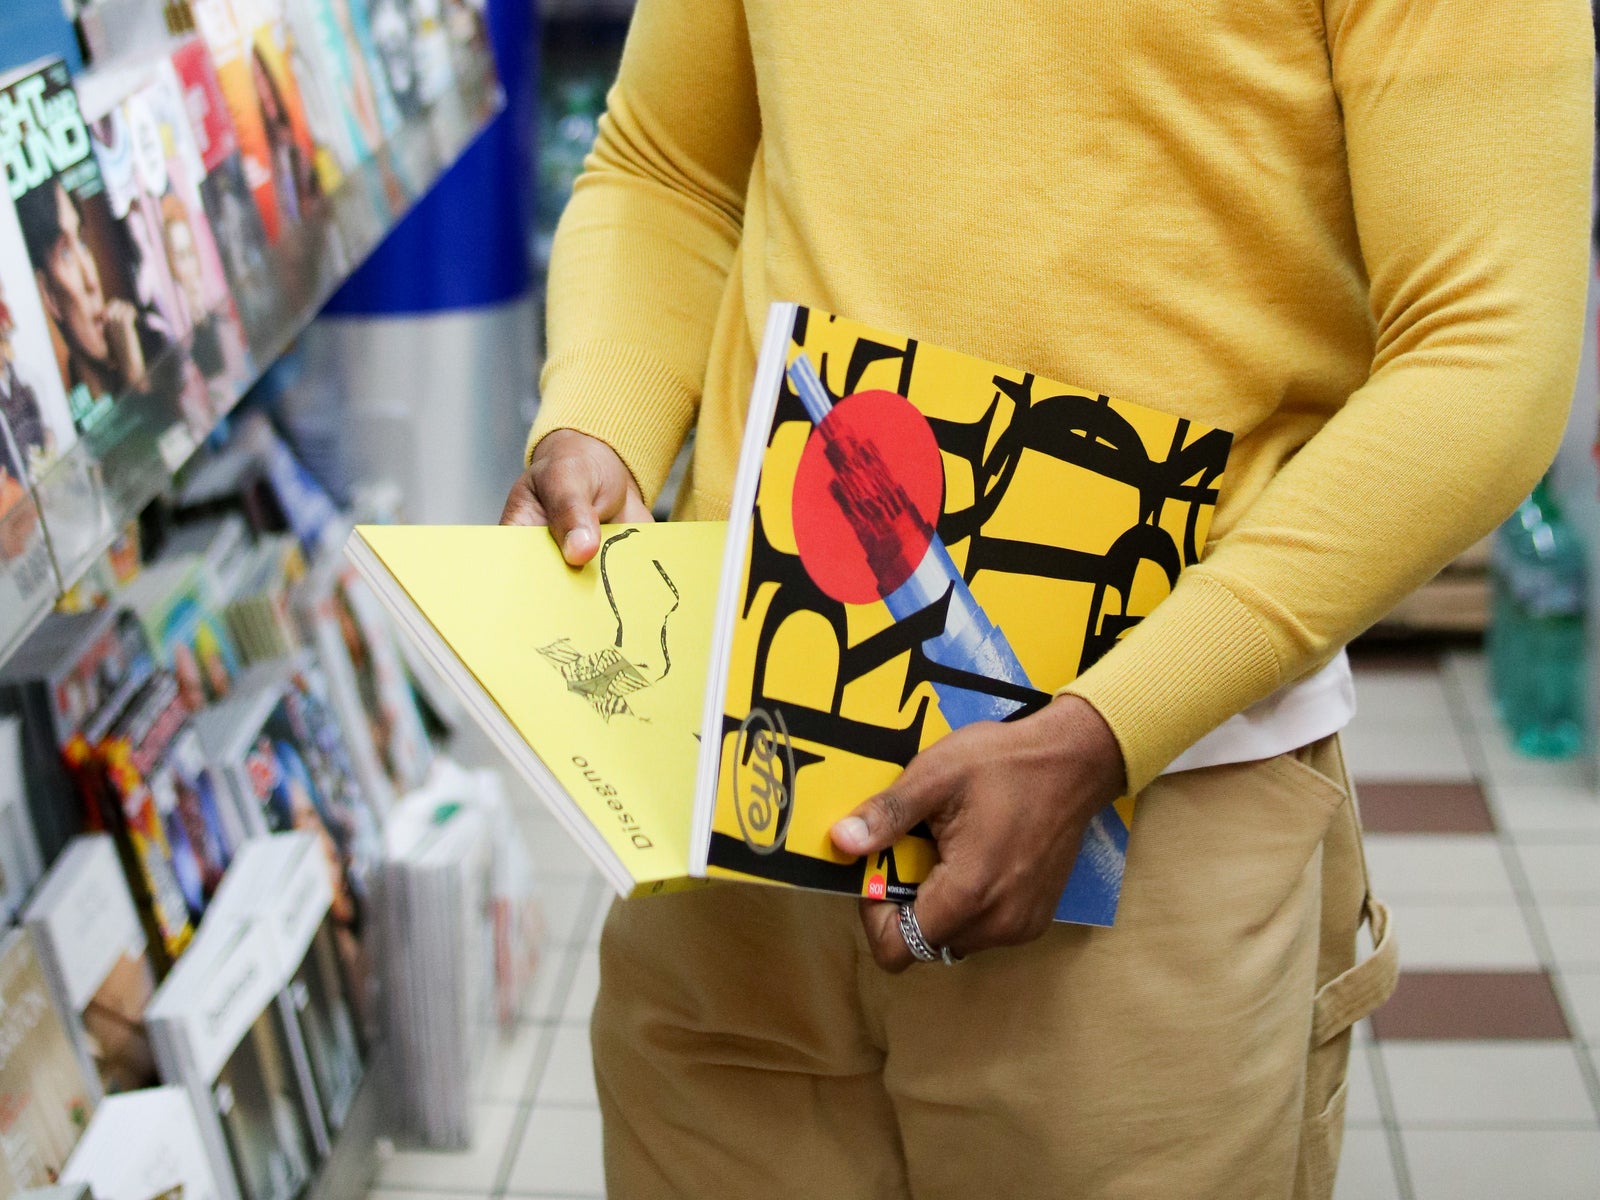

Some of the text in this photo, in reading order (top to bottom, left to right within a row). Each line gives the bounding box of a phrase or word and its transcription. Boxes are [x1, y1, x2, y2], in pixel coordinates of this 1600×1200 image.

[572, 755, 654, 849] Disegno
[748, 729, 788, 832] eye
[869, 882, 884, 895] 108
